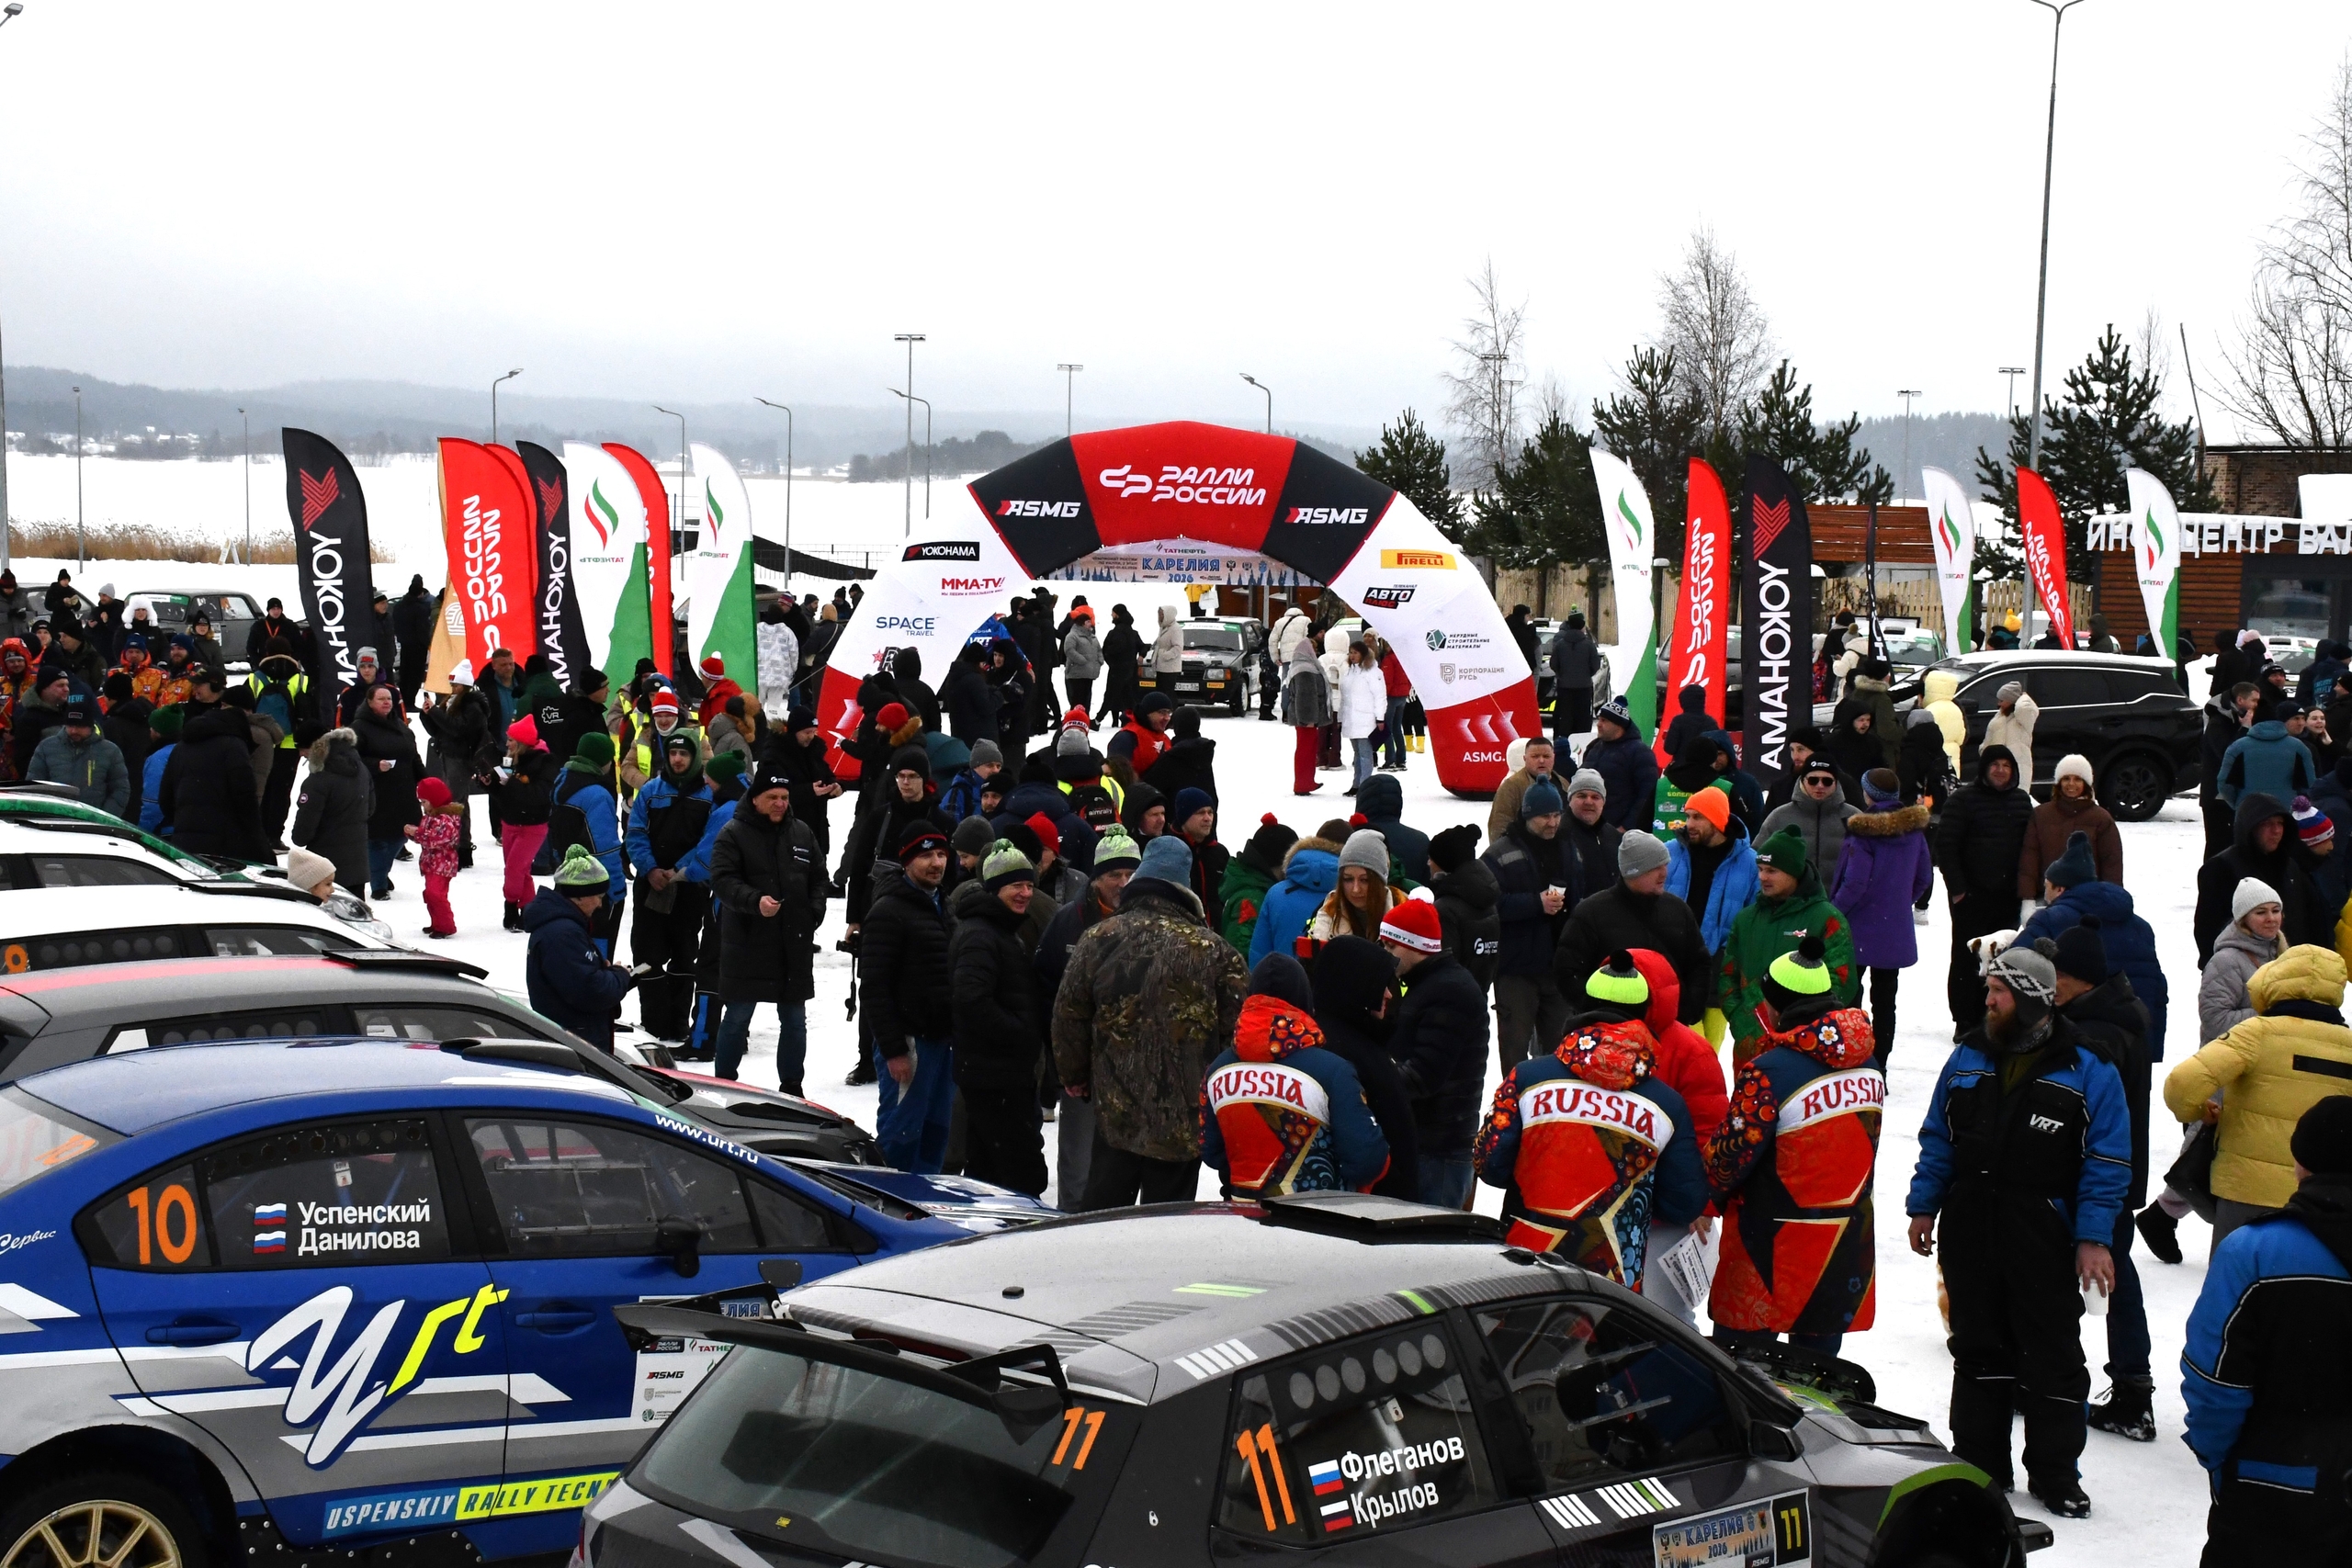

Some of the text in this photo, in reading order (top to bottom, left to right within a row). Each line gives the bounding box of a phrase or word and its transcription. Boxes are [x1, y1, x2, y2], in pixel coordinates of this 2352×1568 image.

[1158, 466, 1254, 486] РАЛЛИ
[1005, 500, 1081, 518] ASMG
[1151, 486, 1267, 506] РОССИИ
[1294, 507, 1369, 525] ASMG
[922, 546, 976, 557] YOKOHAMA
[2086, 521, 2283, 558] ИНЦЕНТР
[1142, 558, 1220, 571] КАРЕЛИЯ
[1396, 552, 1443, 566] PIRELLI
[1168, 573, 1193, 582] 2026
[1364, 598, 1396, 608] ПЛЮС
[1367, 589, 1411, 601] АВТО
[876, 616, 935, 629] SPACE
[1462, 751, 1506, 762] ASMG.
[1212, 1069, 1307, 1111] RUSSIA
[1801, 1076, 1883, 1122] RUSSIA
[1531, 1088, 1656, 1141] RUSSIA
[2030, 1113, 2064, 1133] VRT
[655, 1112, 759, 1165] www.urt.ru
[128, 1184, 198, 1265] 10
[298, 1198, 430, 1225] Успенский
[298, 1227, 421, 1257] Данилова
[1051, 1406, 1105, 1470] 11
[1340, 1436, 1464, 1482] Флеганов
[1237, 1423, 1296, 1531] 11
[325, 1495, 456, 1529] USPENSKIY
[463, 1486, 537, 1513] RALLY
[1350, 1482, 1440, 1529] Крылов
[1685, 1516, 1745, 1546] КАРЕЛИЯ
[1780, 1507, 1802, 1550] 11
[1708, 1541, 1728, 1559] 2026
